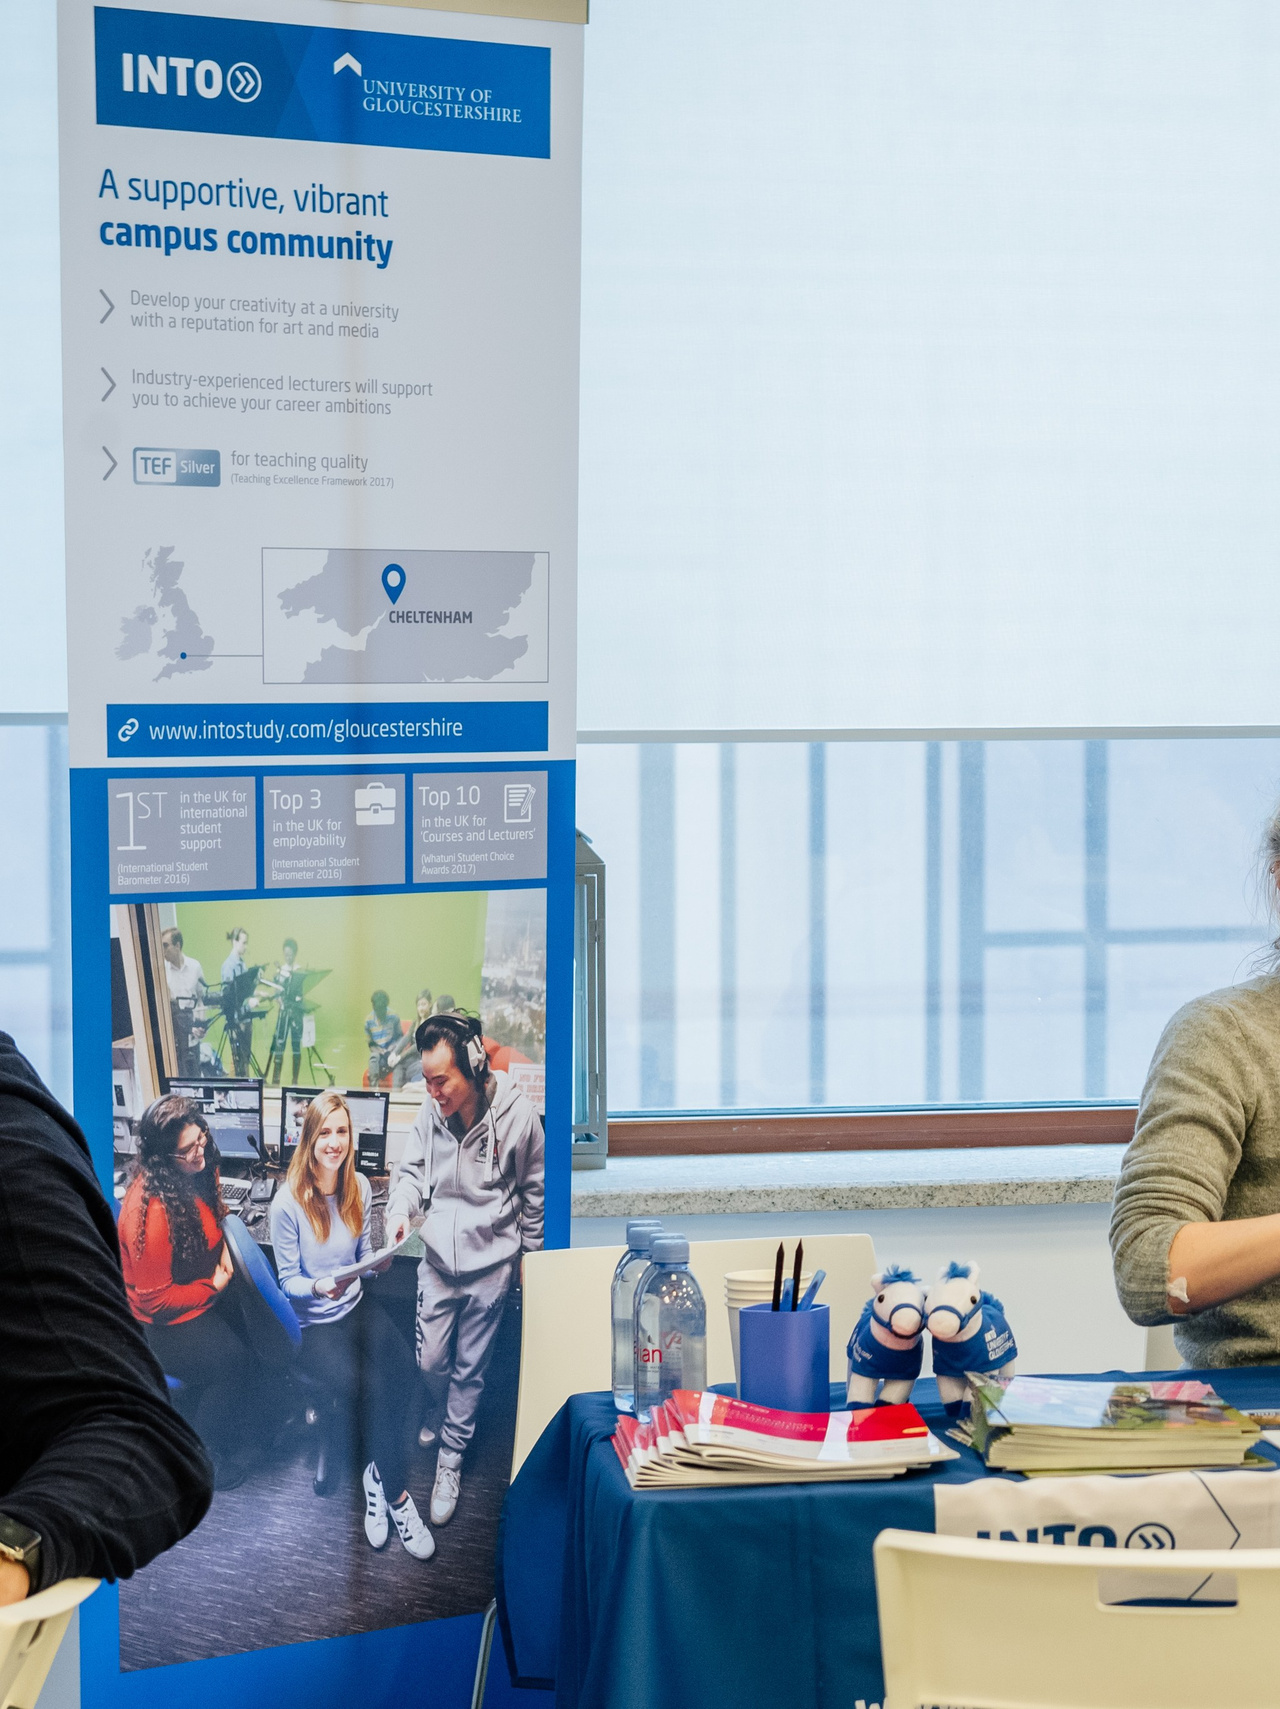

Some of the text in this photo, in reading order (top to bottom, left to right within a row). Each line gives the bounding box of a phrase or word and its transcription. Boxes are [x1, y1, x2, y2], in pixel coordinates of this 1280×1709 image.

[122, 52, 223, 98] INTO
[363, 79, 493, 103] UNIVERSITY OF
[363, 97, 522, 124] GLOUCESTERSHIRE
[99, 168, 389, 218] A supportive, vibrant
[100, 222, 393, 270] campus community
[130, 290, 399, 322] Develop your creativity at a university
[130, 313, 379, 338] with a reputation for art and media
[132, 368, 432, 398] Industry-experienced lecturers will support
[132, 392, 391, 415] you to achieve your career ambitions
[140, 456, 215, 476] TEF Silver
[231, 450, 368, 472] for teaching quality
[230, 474, 394, 488] (Teaching Excellence Framework 2017)
[389, 610, 472, 624] CHELTENHAM
[150, 718, 463, 743] www.intostudy.com/gloucestershire
[180, 790, 246, 803] in the UK for
[270, 789, 321, 814] Top 3
[419, 786, 480, 810] Top 10
[180, 806, 248, 818] international
[116, 792, 168, 850] 1ST
[180, 822, 222, 834] student
[273, 820, 341, 832] in the UK for
[422, 816, 486, 828] in the UK for
[273, 834, 346, 848] employability
[466, 830, 485, 841] and
[180, 837, 222, 852] support
[272, 858, 360, 869] (International Student
[422, 852, 514, 864] (Whatuni Student Choice
[118, 862, 208, 874] (International Student
[272, 869, 342, 880] Barometer 2016)
[422, 864, 476, 875] Awards 2017)
[118, 874, 190, 886] Barometer 2016)
